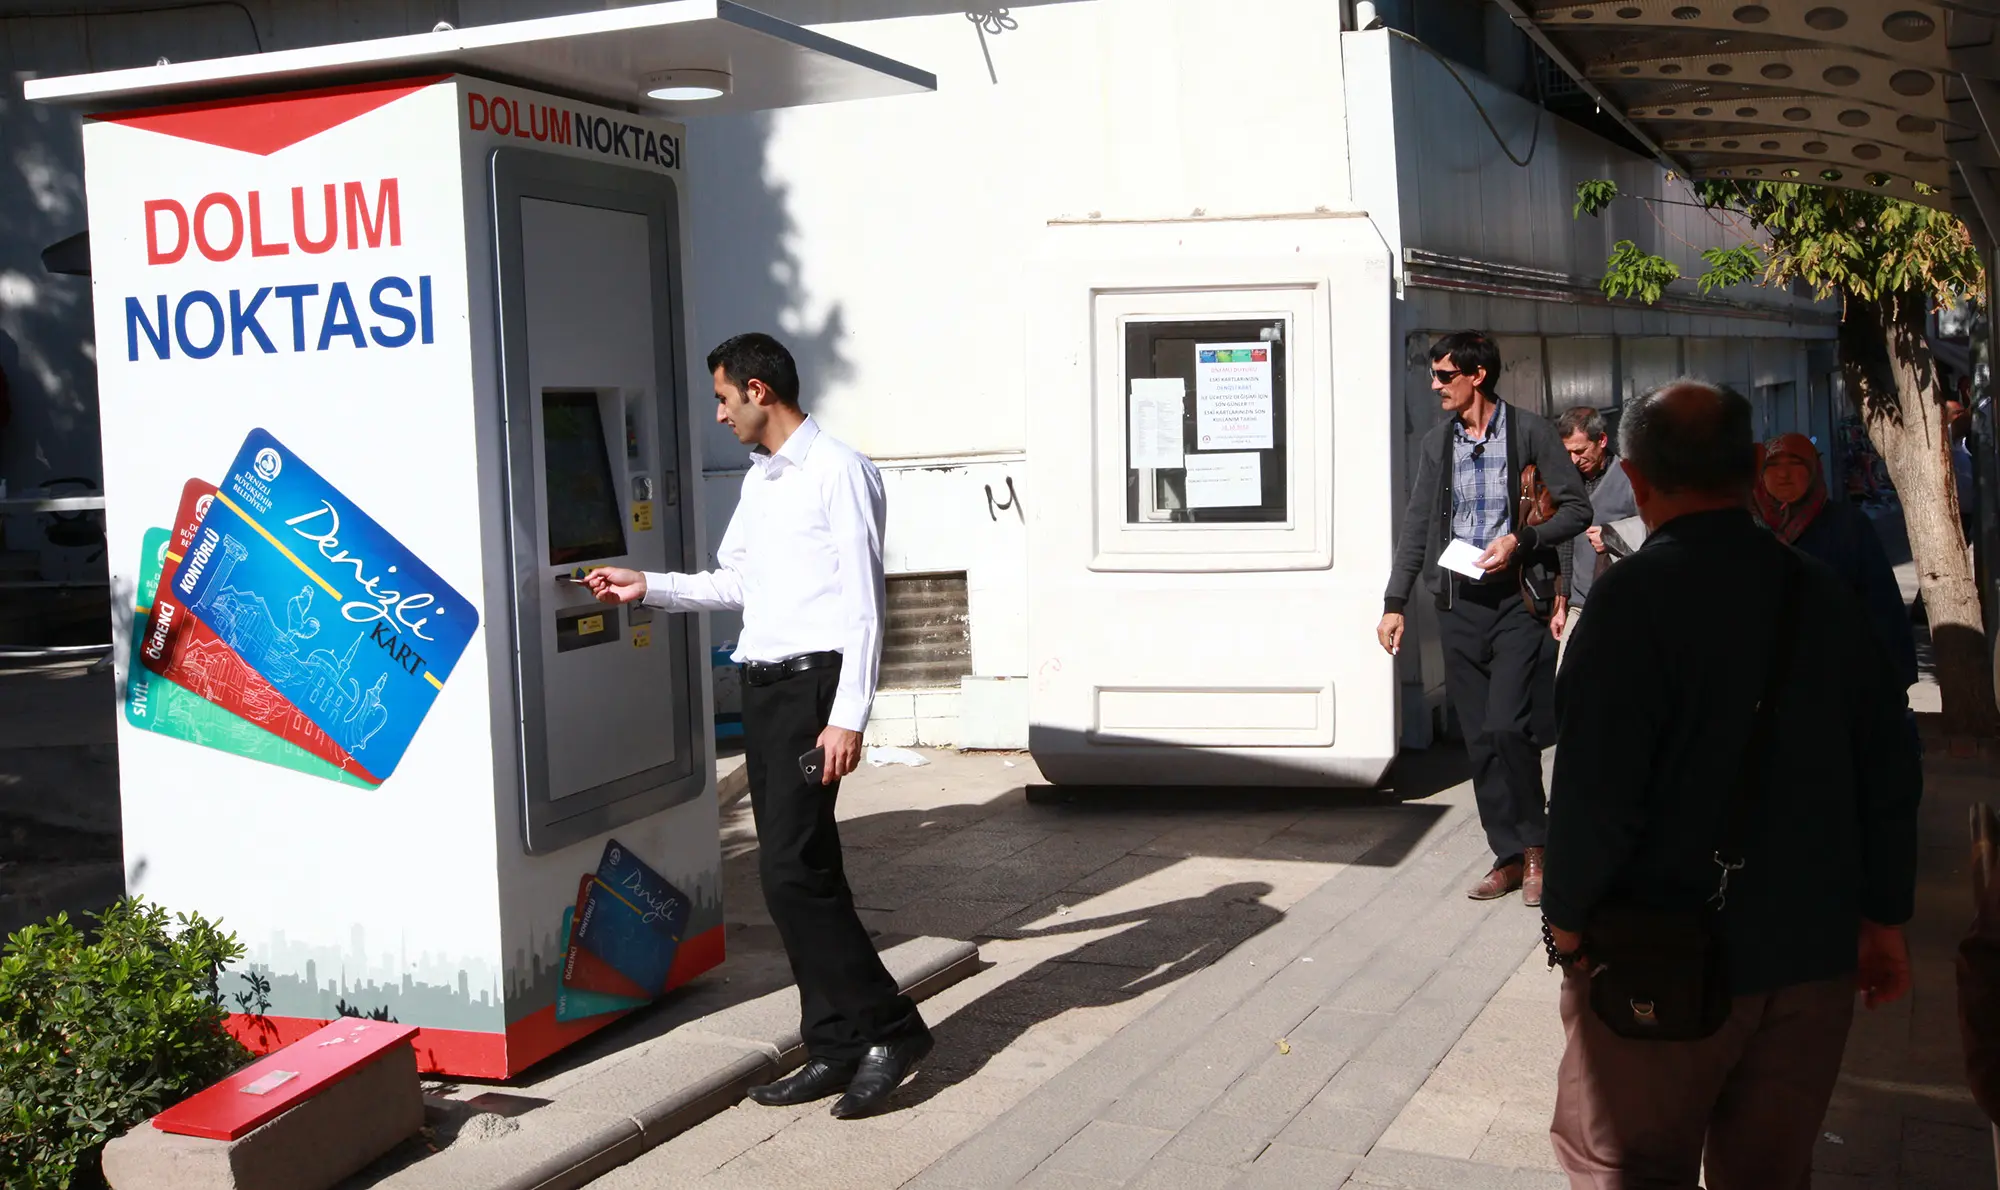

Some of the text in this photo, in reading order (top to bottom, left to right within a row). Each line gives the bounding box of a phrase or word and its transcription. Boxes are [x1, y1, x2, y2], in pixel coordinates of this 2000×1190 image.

[468, 92, 680, 169] DOLUM NOKTASI
[144, 177, 402, 266] DOLUM
[125, 275, 434, 362] NOKTASI
[232, 483, 267, 514] BELEDİYESİ
[234, 473, 273, 509] BÜYÜKŞEHİR
[244, 471, 271, 496] DENİZLİ
[179, 527, 220, 595] KONTÖRLÜ
[285, 499, 445, 642] Denizli
[146, 600, 175, 660] ÖĞRENCİ
[369, 621, 427, 677] KART
[131, 681, 149, 718] SİVİL
[622, 868, 679, 924] Denizli
